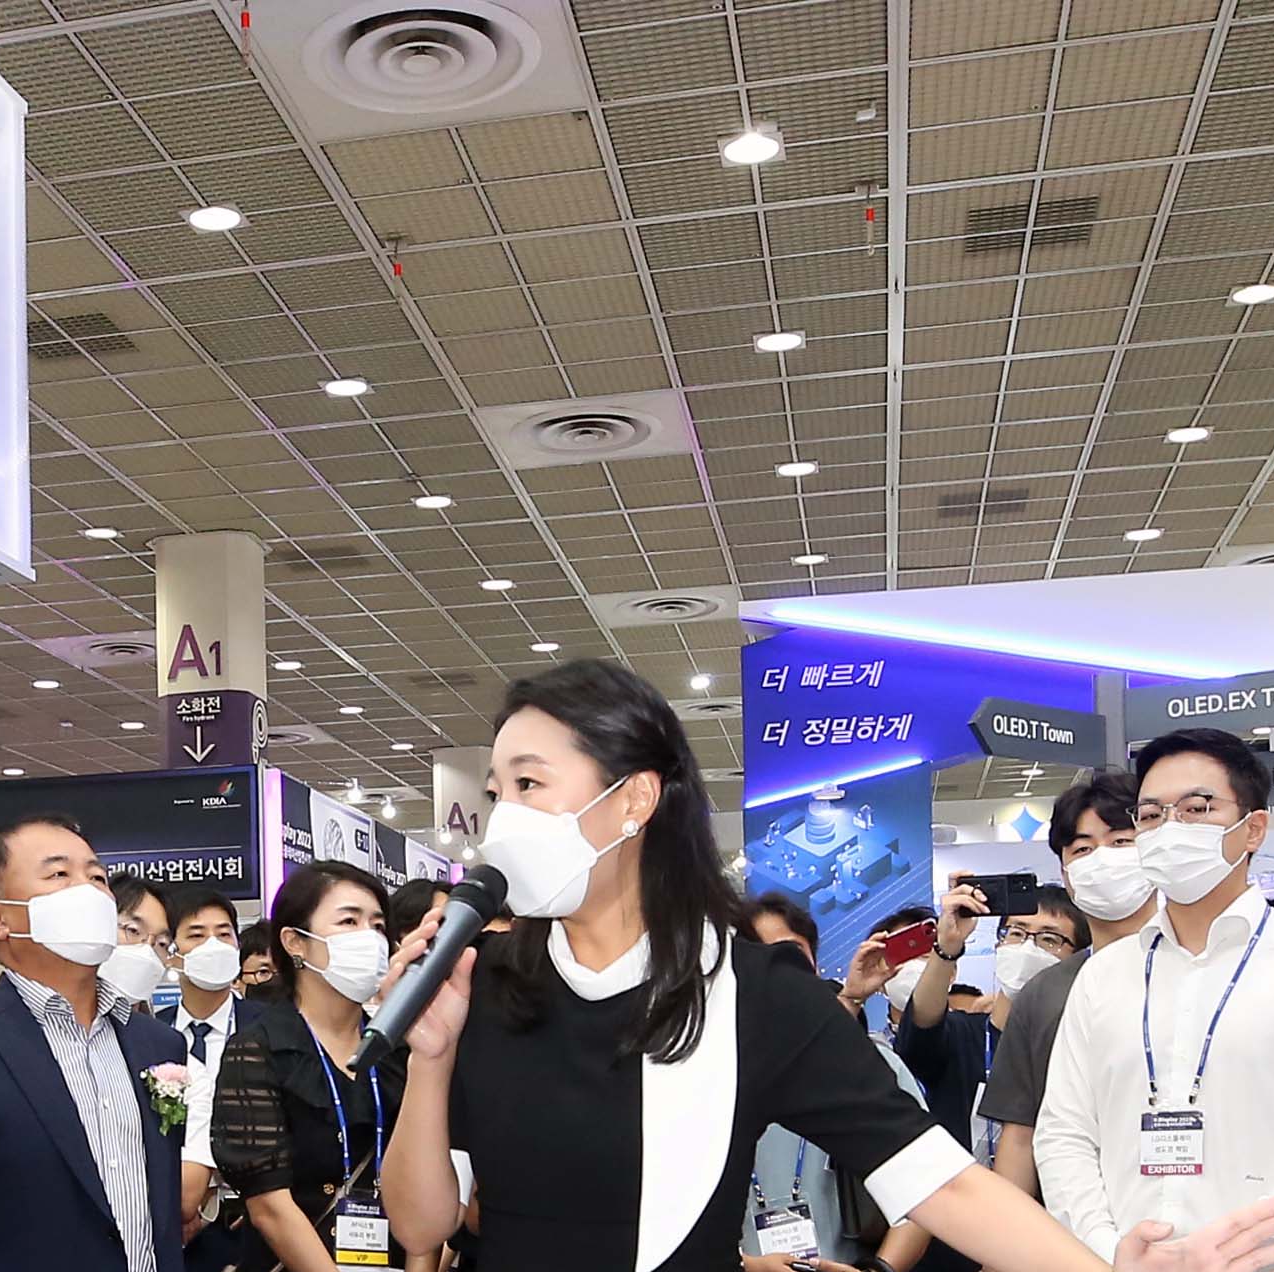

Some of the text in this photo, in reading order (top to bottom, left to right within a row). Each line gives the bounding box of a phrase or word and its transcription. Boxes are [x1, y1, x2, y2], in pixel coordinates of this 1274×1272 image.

[167, 623, 222, 681] A1
[761, 659, 885, 693] 더 빠르게
[175, 695, 222, 716] 소화전
[1167, 689, 1257, 719] OLED.EX
[762, 713, 914, 747] 더 정밀하게
[992, 714, 1075, 746] OLED.T Town
[446, 801, 479, 836] A1
[108, 855, 244, 883] 레이산업전시회
[1147, 1164, 1196, 1174] EXHIBITOR
